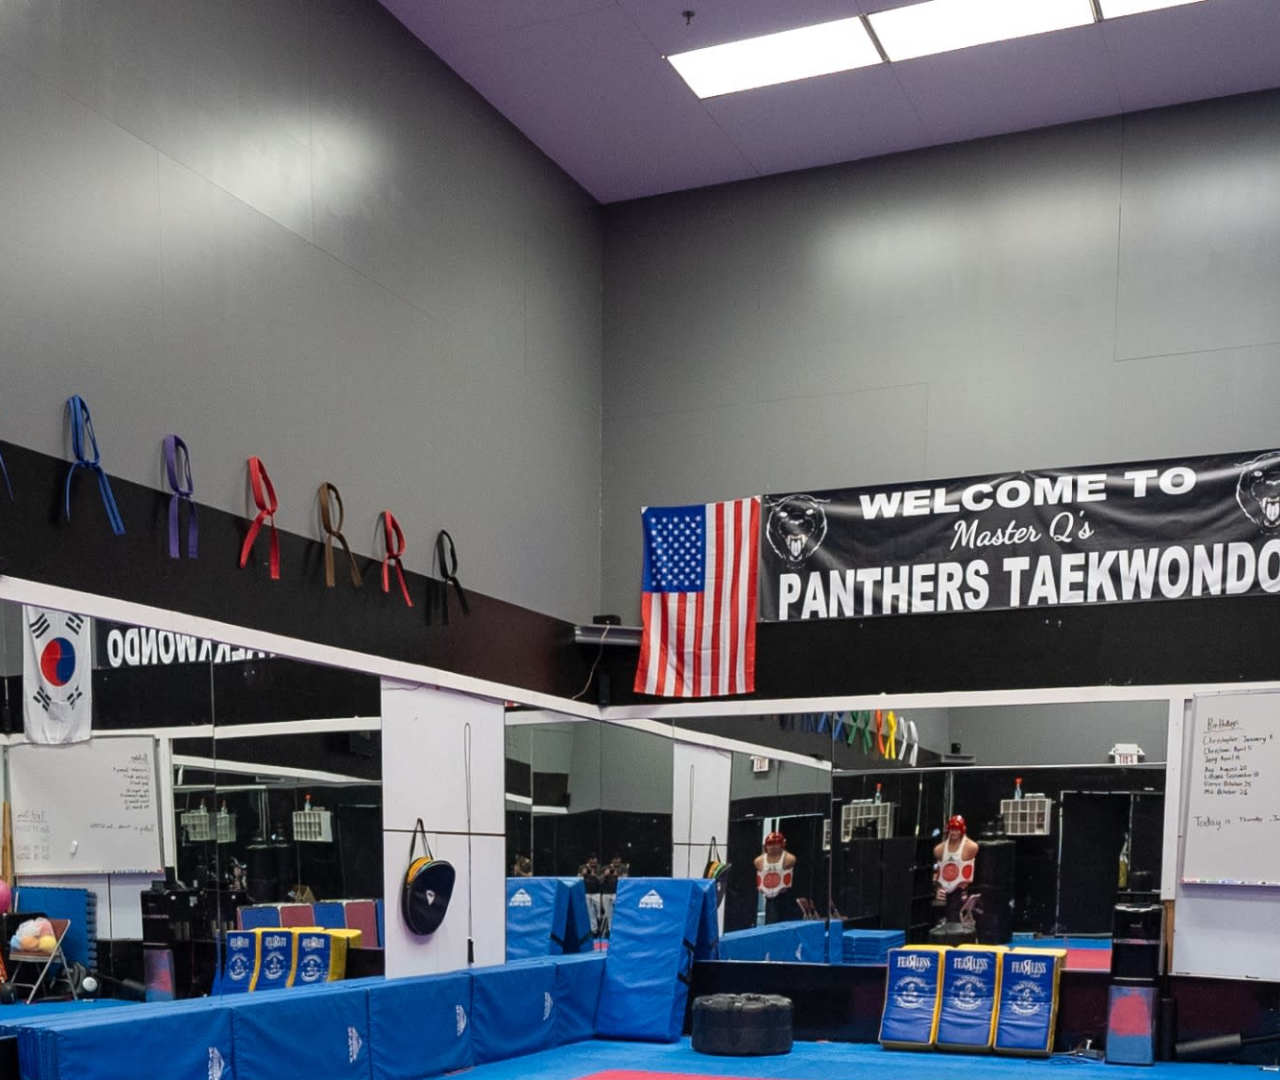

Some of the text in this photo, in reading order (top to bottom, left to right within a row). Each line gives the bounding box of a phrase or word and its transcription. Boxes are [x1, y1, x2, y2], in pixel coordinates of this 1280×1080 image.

[859, 466, 1196, 519] WELCOME TO
[950, 508, 1095, 552] Master Q's
[778, 558, 989, 620] PANTHERS
